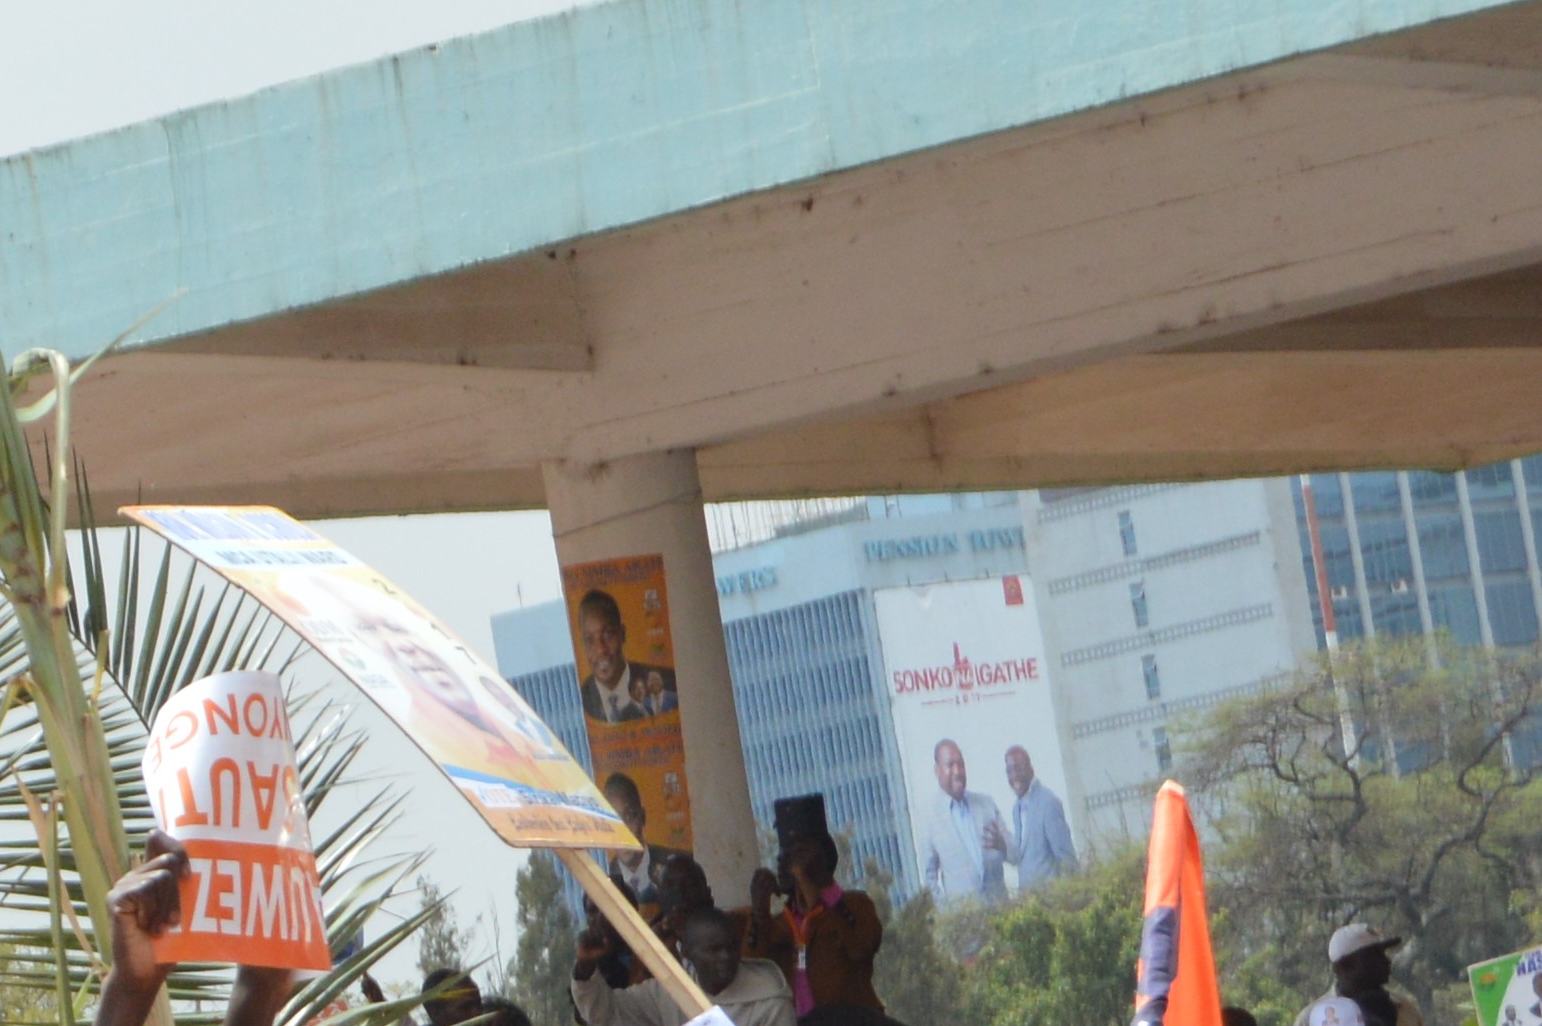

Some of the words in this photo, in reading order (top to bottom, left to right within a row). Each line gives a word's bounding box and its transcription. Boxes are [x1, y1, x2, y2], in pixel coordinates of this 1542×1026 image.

[893, 665, 954, 694] SONKO
[974, 657, 1040, 686] IGATHE
[159, 757, 296, 836] SAUTI
